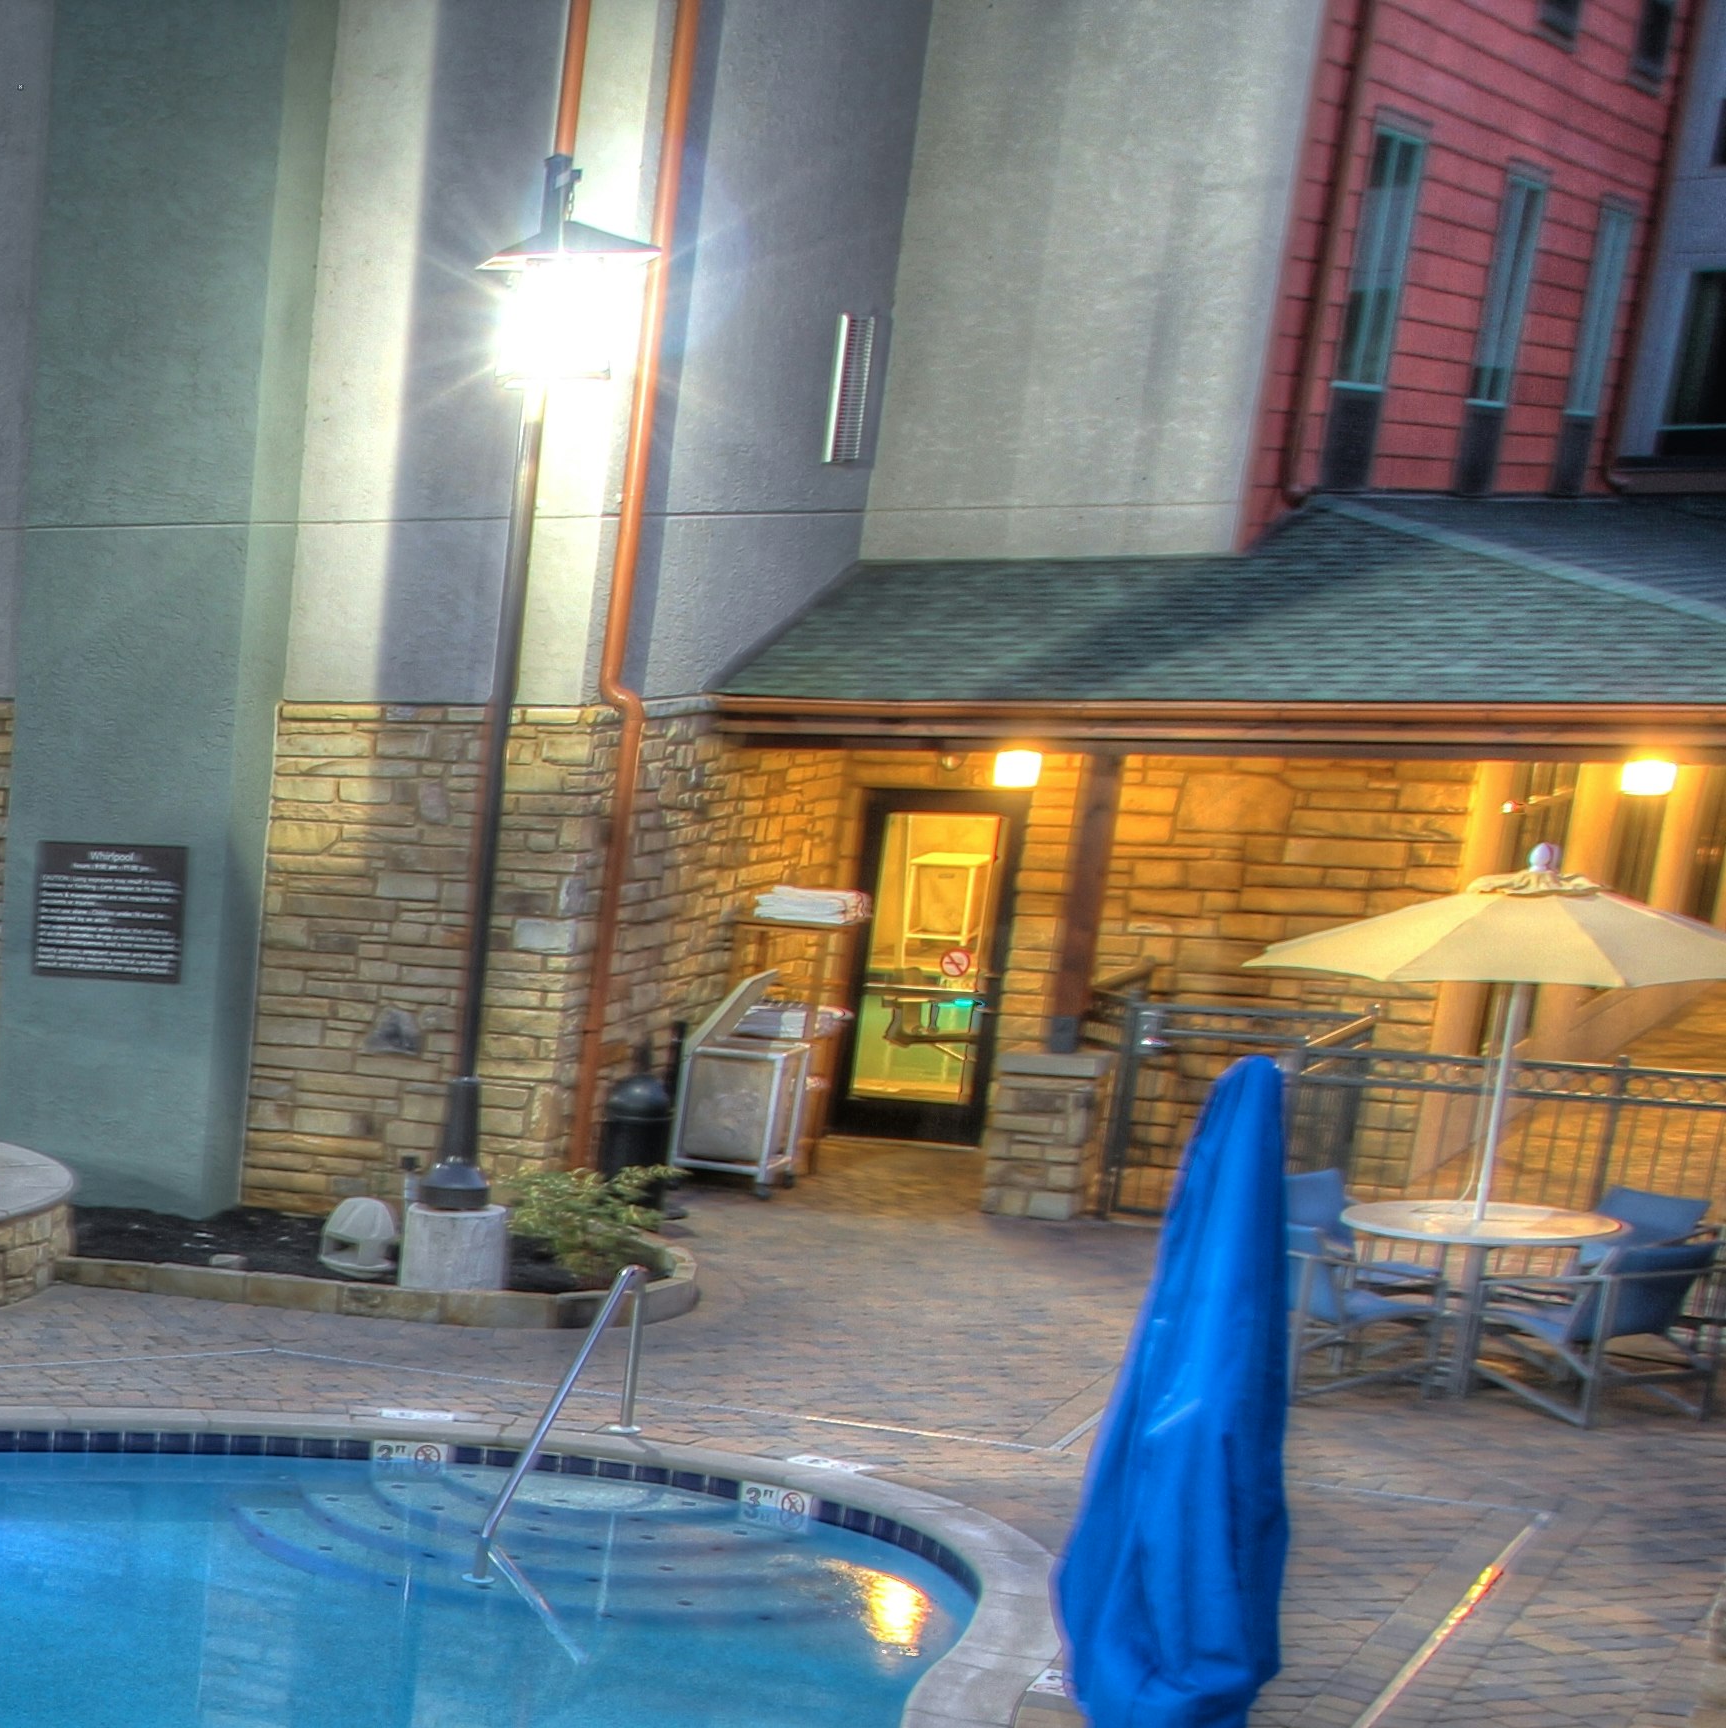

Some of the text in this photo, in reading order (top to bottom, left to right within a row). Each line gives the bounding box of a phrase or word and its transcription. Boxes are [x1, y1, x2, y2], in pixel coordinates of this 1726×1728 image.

[88, 851, 136, 863] Whirlpool
[377, 1444, 407, 1461] 2 FT
[745, 1487, 775, 1507] 3 FT
